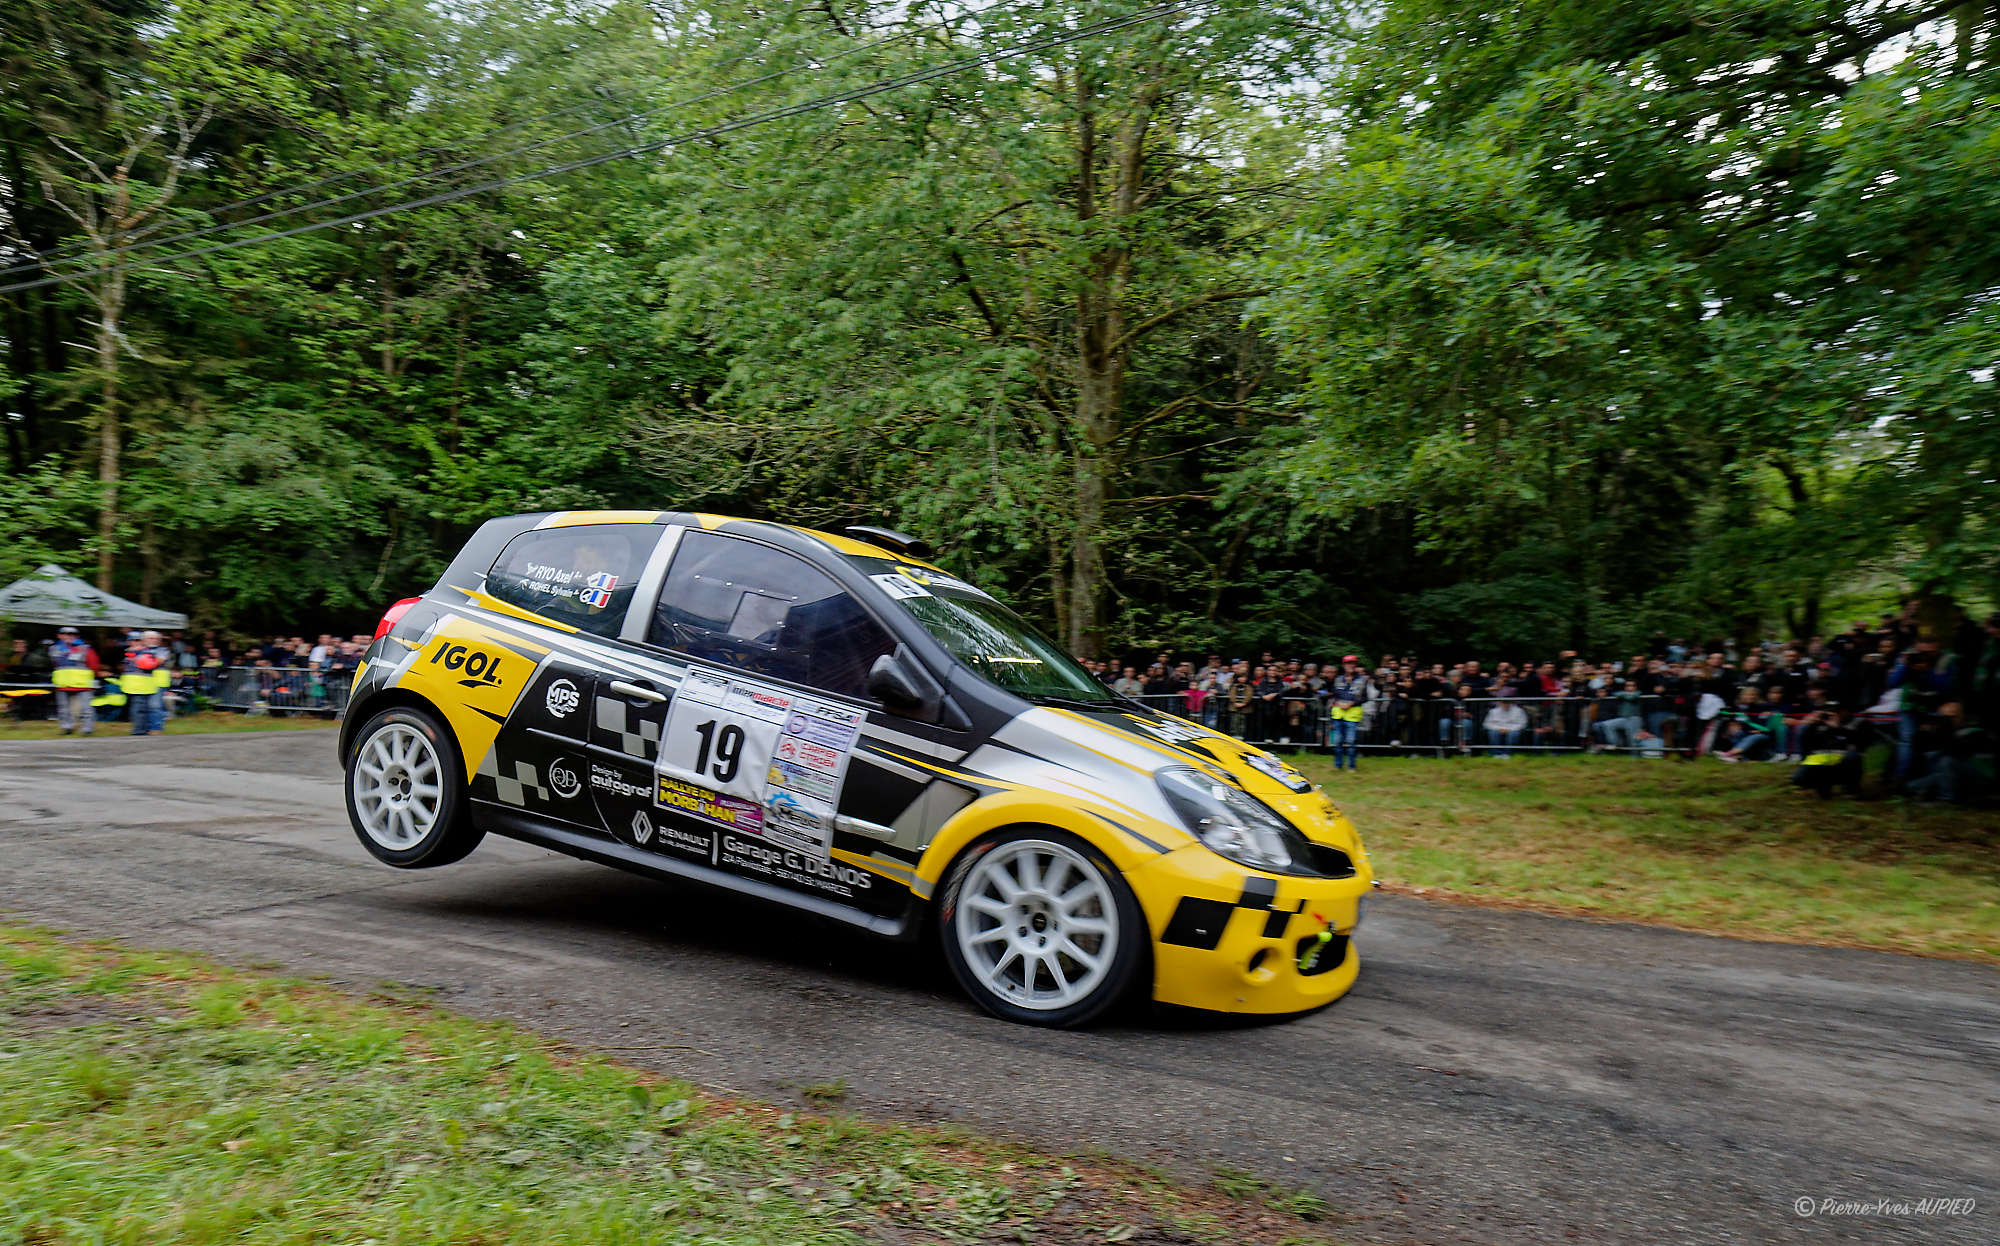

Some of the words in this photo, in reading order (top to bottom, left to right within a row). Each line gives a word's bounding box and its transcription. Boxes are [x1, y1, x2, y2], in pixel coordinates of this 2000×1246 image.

[535, 565, 555, 580] RYO
[552, 569, 575, 584] Axel
[547, 686, 580, 707] MPS
[695, 720, 745, 783] 19
[591, 774, 652, 798] autograf
[659, 777, 699, 797] RALLYE
[658, 825, 711, 848] RENAULT
[722, 835, 783, 866] Garage
[783, 850, 804, 871] G.
[804, 856, 872, 889] DENOS
